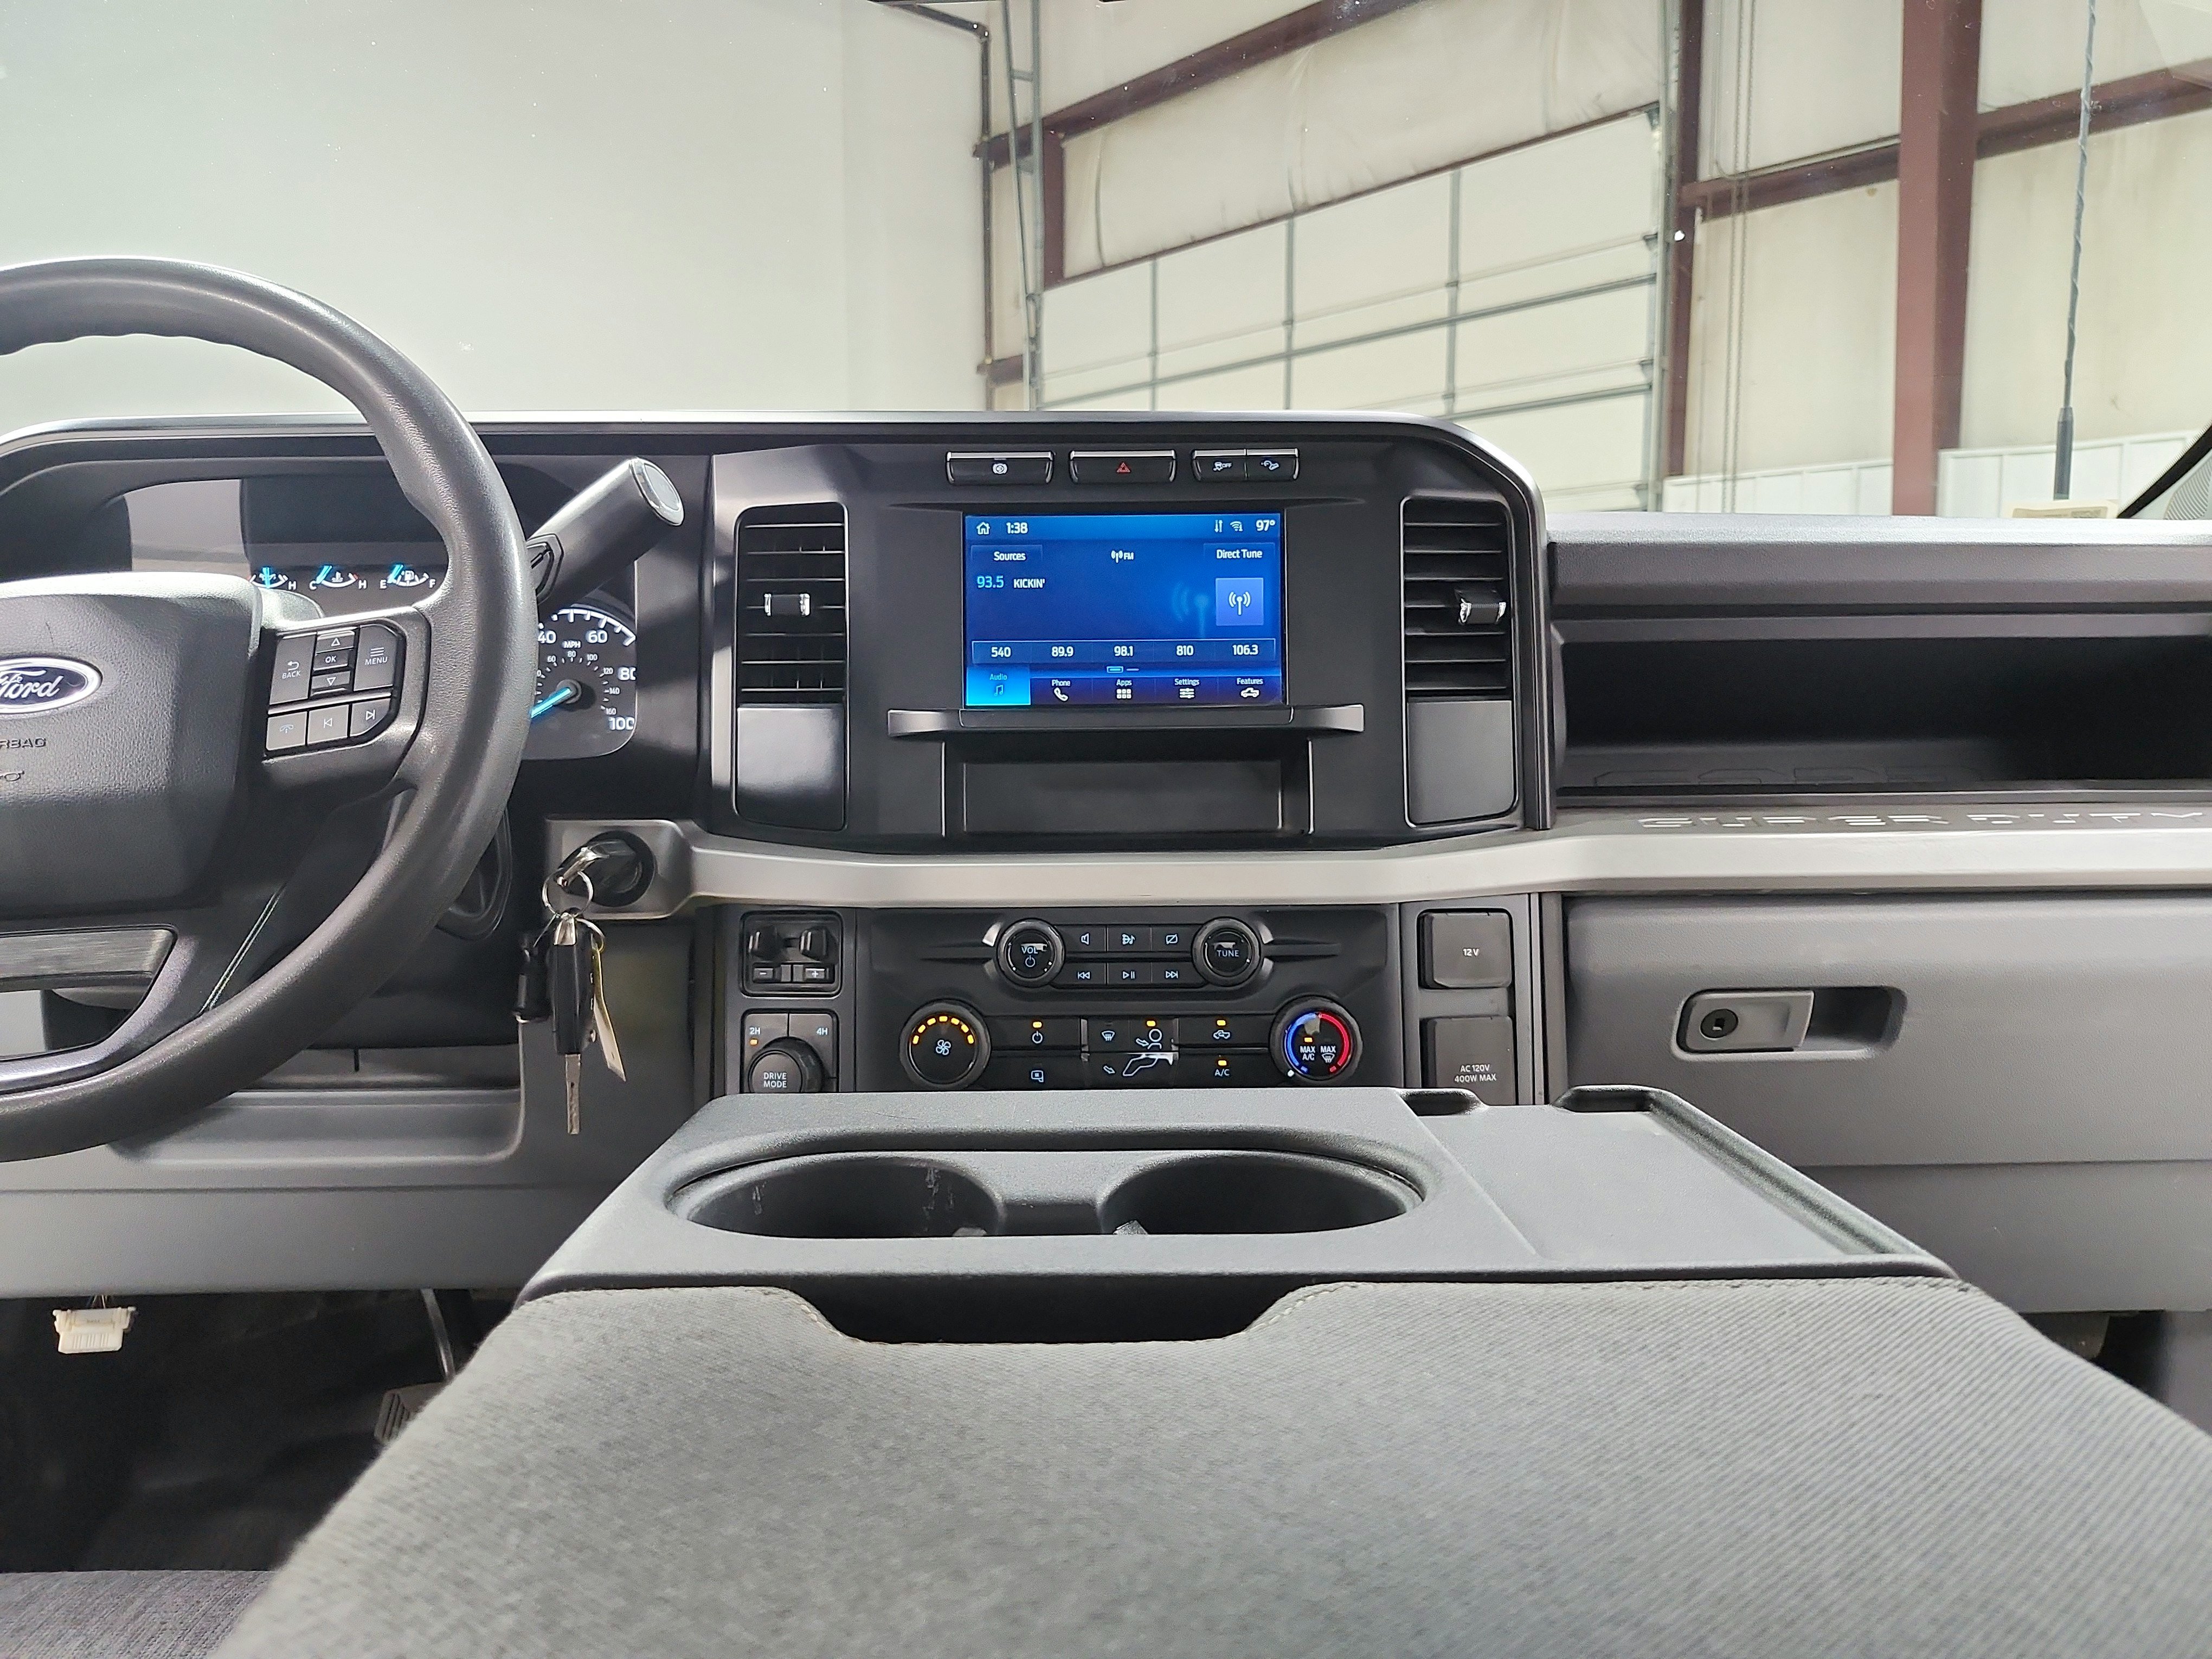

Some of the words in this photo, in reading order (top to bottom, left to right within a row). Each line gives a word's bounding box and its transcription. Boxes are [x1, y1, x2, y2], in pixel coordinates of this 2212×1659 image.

[1006, 522, 1028, 534] 1:38
[1256, 519, 1276, 531] 97°
[993, 551, 1026, 562] Sources
[1216, 549, 1239, 559] Direct
[1241, 549, 1263, 558] Tune
[976, 576, 1005, 589] 93.5
[1013, 578, 1045, 589] KICKIN'
[537, 631, 557, 644] 40
[587, 631, 608, 644] 60
[991, 646, 1011, 658] 540
[1051, 646, 1074, 657] 89.9
[1114, 646, 1134, 657] 98.1
[1176, 645, 1194, 656] 810
[1232, 644, 1258, 655] 106.3
[325, 655, 337, 664] OK
[365, 657, 388, 665] MENU
[282, 670, 301, 679] BACK
[0, 670, 64, 699] Ford
[1174, 678, 1200, 686] Settings
[1237, 677, 1263, 685] Features
[608, 717, 634, 730] 100
[1637, 814, 1950, 828] SUPER
[1966, 812, 2203, 825] DUTY
[1460, 1064, 1471, 1072] AC
[763, 1072, 787, 1080] DRIVE
[1454, 1075, 1477, 1083] 400W
[1479, 1073, 1497, 1082] MAX
